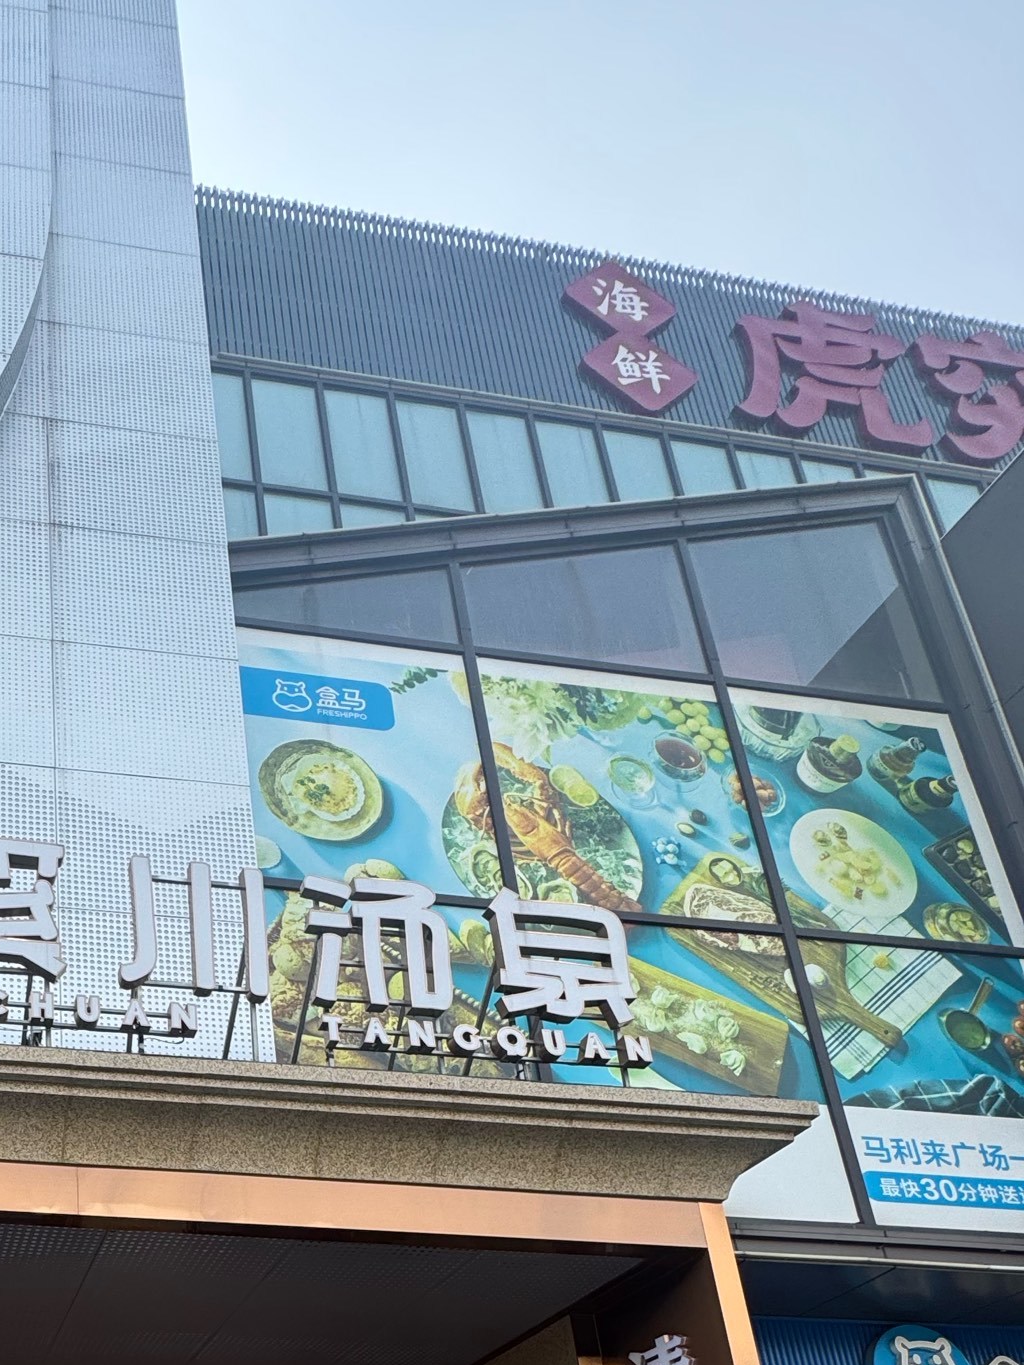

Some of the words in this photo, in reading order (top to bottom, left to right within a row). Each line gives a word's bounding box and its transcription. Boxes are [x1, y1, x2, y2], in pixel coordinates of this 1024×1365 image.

[592, 278, 671, 394] 海鲜
[316, 685, 366, 711] 盒马
[317, 708, 367, 721] FRESHIPPO
[318, 1013, 654, 1069] TANGQUAN
[879, 1177, 1024, 1206] 最快30分钟送
